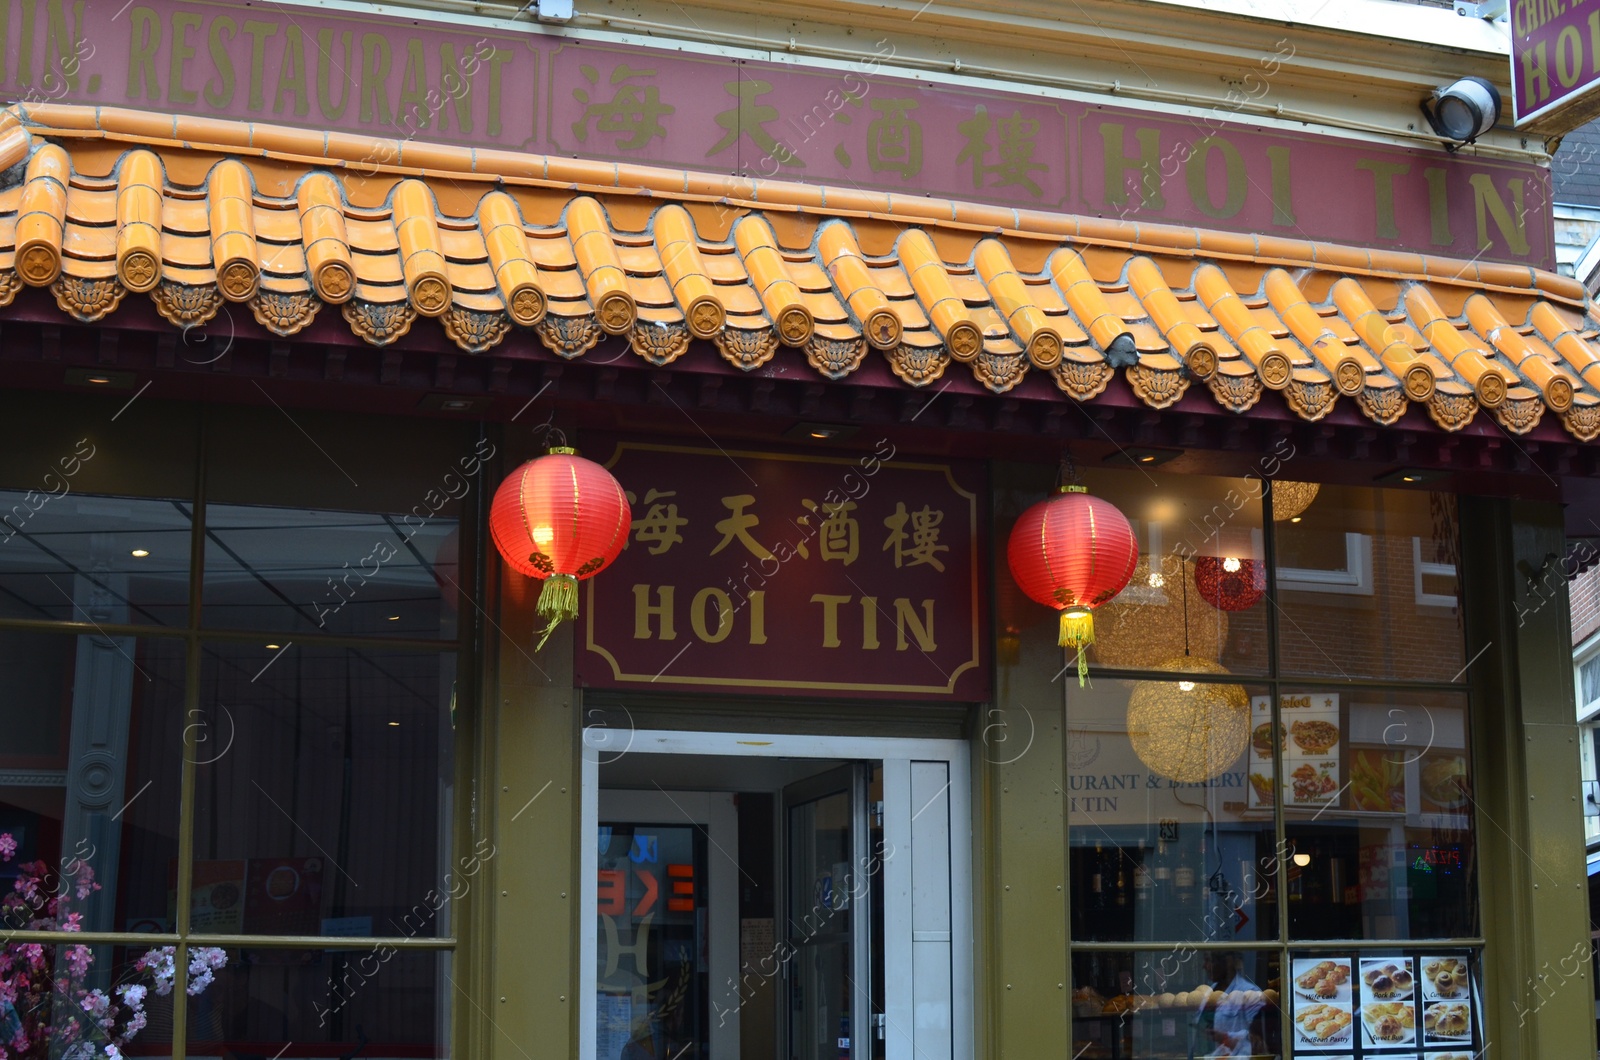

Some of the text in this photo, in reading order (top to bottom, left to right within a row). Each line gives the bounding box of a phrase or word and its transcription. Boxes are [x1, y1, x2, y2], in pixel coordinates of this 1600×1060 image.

[0, 0, 514, 137] IN. RESTAURANT
[571, 63, 1050, 198] 海天酒樓
[1099, 122, 1531, 256] HOI TIN
[624, 488, 950, 573] 海天酒樓
[632, 584, 938, 652] HOI TIN
[1067, 774, 1140, 790] URANT
[1081, 796, 1118, 812] TIN
